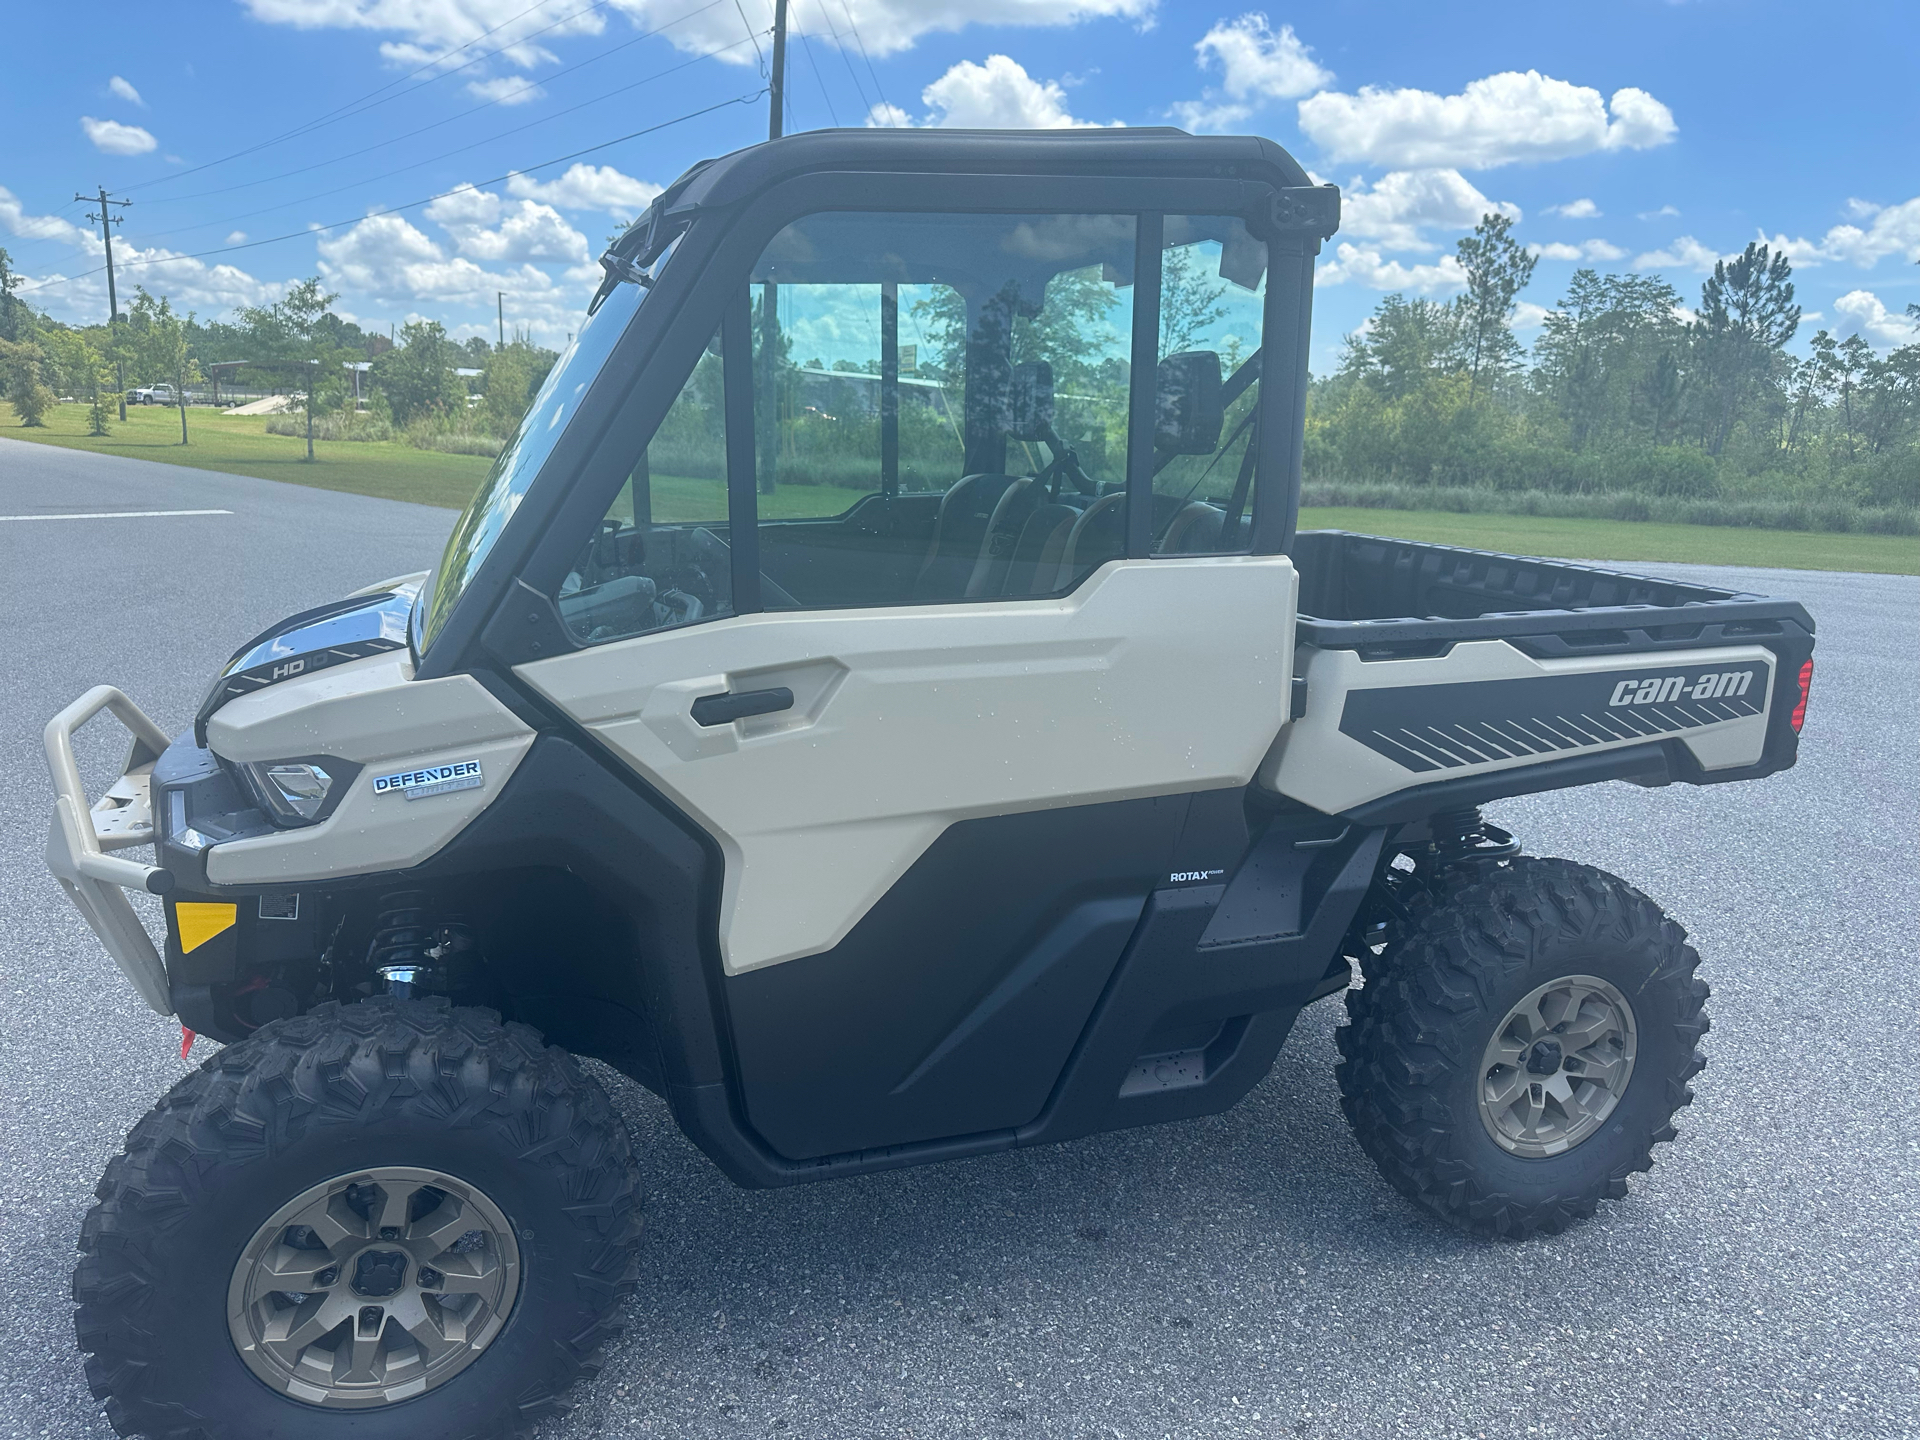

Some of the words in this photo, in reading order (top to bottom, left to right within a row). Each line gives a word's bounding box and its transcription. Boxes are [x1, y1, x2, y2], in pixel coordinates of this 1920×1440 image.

[273, 652, 329, 680] HD10
[376, 762, 478, 791] DEFENDER
[1170, 870, 1208, 881] ROTAX
